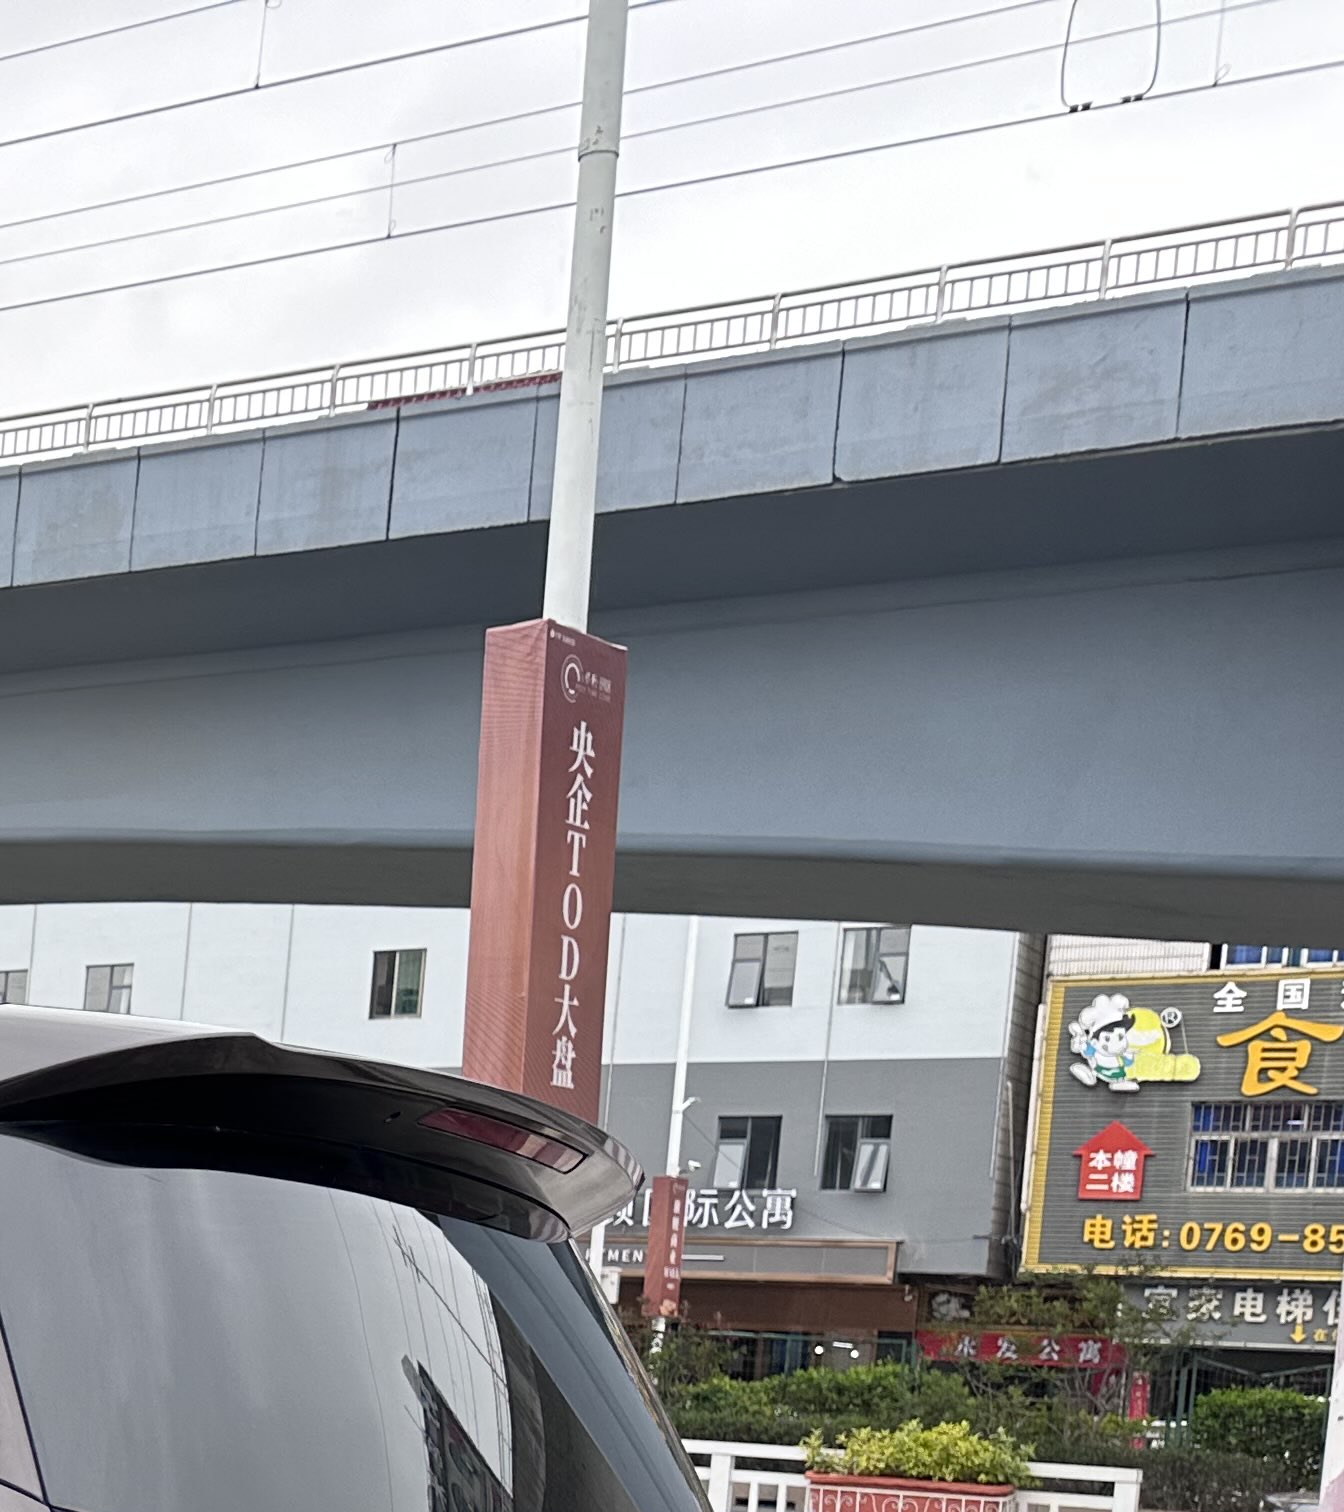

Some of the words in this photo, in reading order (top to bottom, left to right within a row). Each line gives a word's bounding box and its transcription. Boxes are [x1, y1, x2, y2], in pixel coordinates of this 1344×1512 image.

[550, 720, 596, 1090] 央企TOD大盘
[1212, 977, 1344, 1013] 全国
[1216, 1010, 1344, 1097] 食
[1085, 1171, 1135, 1193] 二楼
